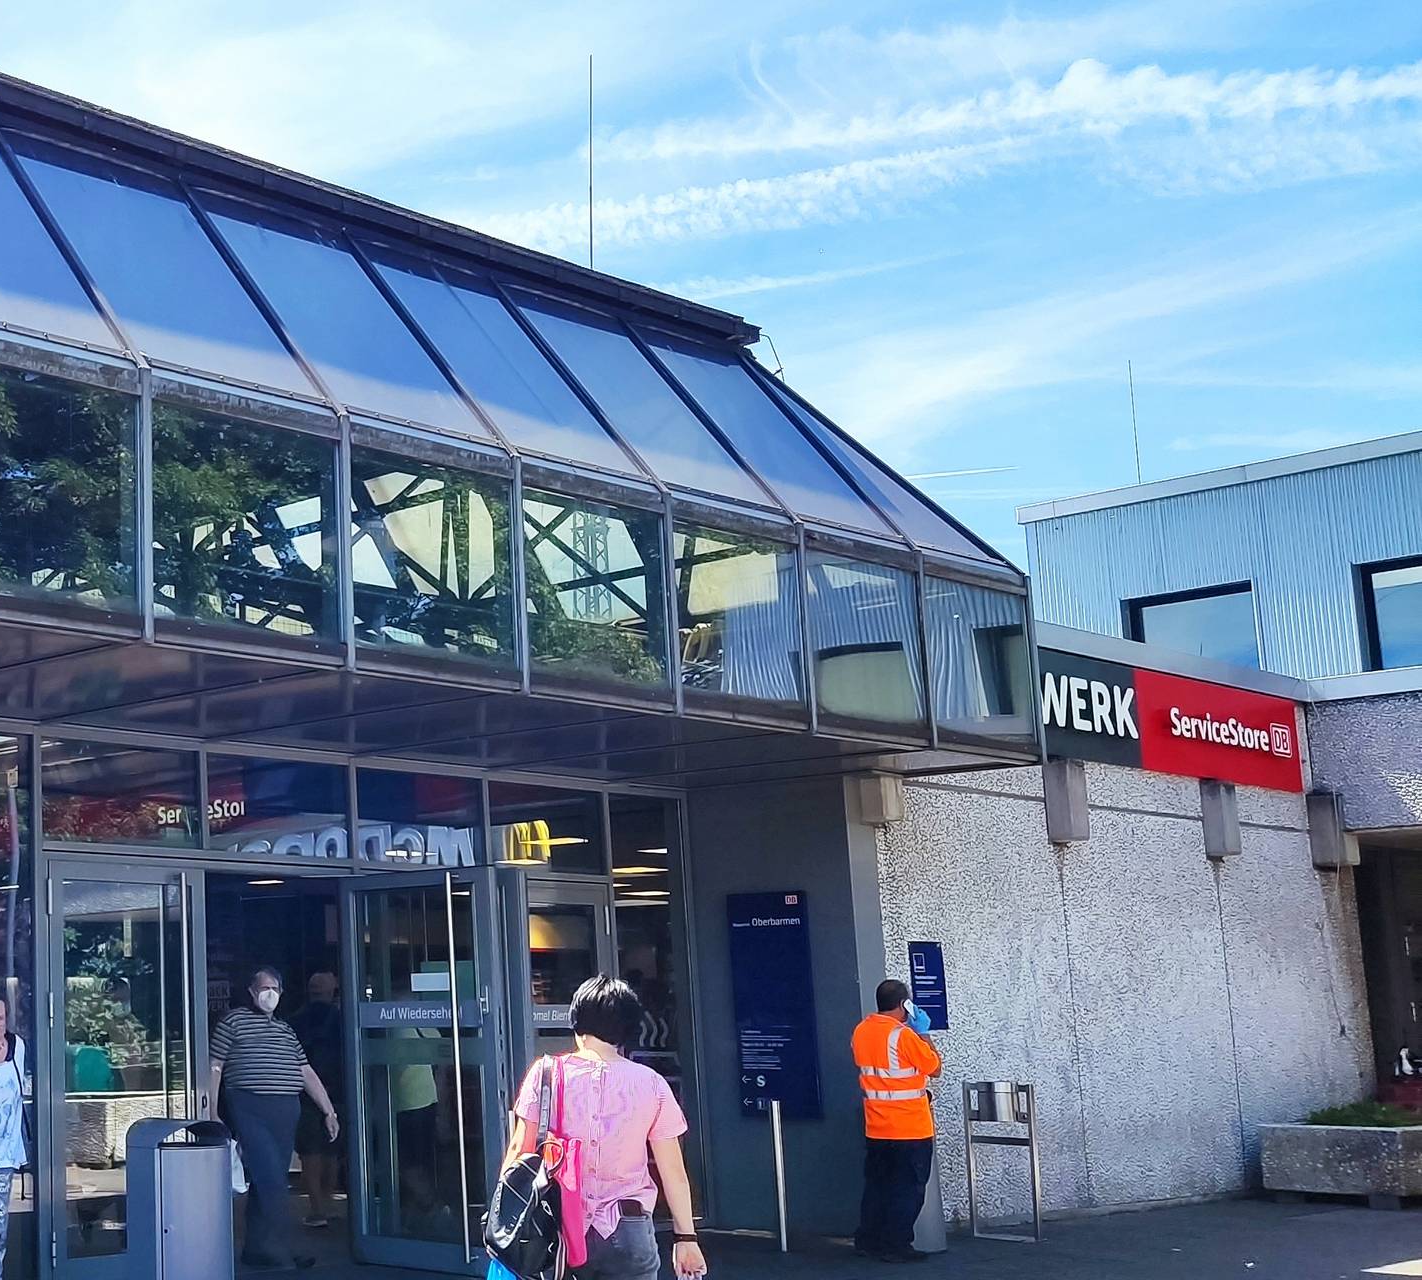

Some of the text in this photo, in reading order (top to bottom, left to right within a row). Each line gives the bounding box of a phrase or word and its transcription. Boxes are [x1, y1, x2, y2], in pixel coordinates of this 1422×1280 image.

[1042, 672, 1139, 740] WERK
[1169, 706, 1290, 753] ServiceStore DB
[751, 917, 801, 927] Oberbarmen
[380, 1007, 396, 1020] Auf
[756, 1075, 766, 1087] S
